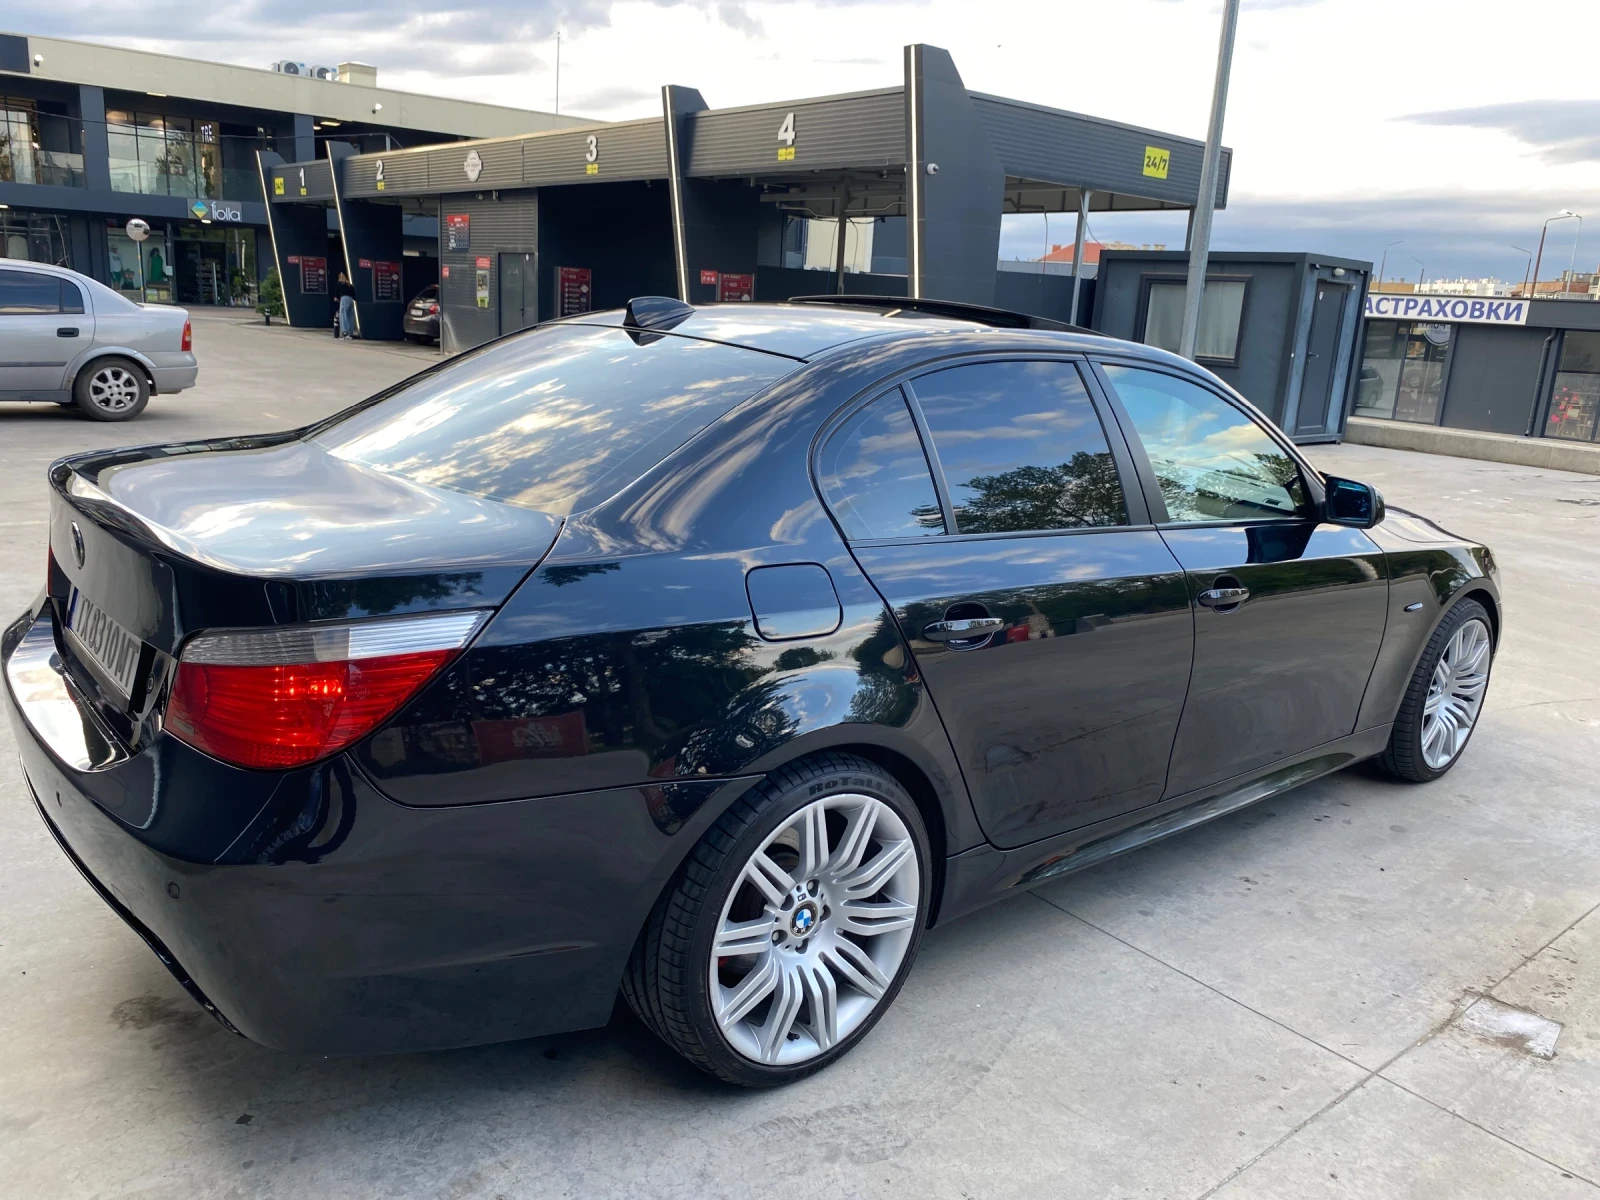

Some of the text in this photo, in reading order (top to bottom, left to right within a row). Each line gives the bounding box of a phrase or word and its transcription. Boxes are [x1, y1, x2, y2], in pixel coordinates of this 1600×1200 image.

[777, 112, 796, 146] 4
[585, 135, 599, 162] 3
[376, 160, 385, 180] 2
[1145, 155, 1168, 171] 24/7
[299, 167, 305, 187] 1
